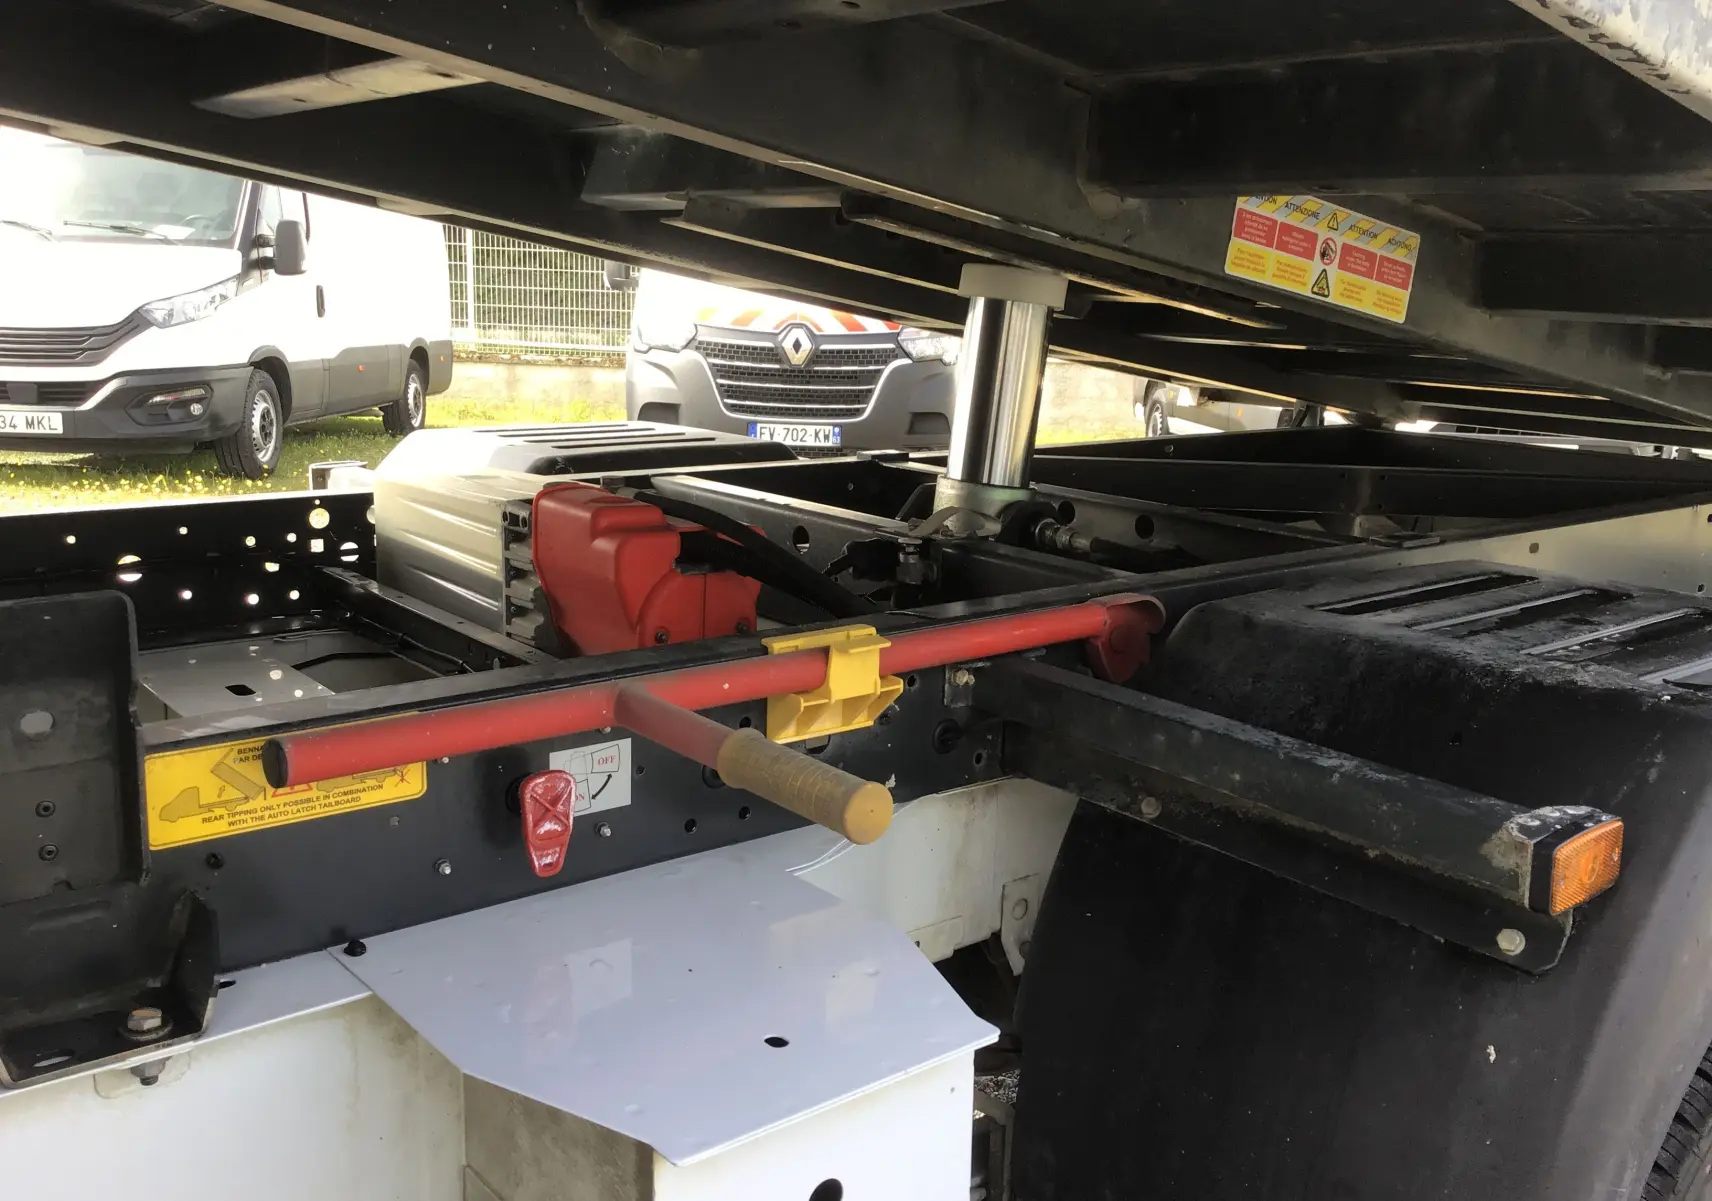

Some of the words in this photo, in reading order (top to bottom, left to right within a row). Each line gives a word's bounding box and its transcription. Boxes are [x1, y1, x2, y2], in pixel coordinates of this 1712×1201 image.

[1284, 201, 1321, 220] ATTENZIONE
[1348, 225, 1378, 240] ATTENTION
[25, 415, 58, 431] MKL
[597, 755, 616, 765] OFF
[201, 814, 225, 825] REAR
[226, 808, 258, 819] TIPPING
[259, 803, 282, 813] ONLY
[283, 795, 321, 808] POSSIBLE
[322, 793, 331, 801] IN
[332, 783, 384, 799] COMBINATION
[227, 818, 248, 828] WITH
[250, 814, 265, 823] THE
[267, 810, 289, 820] AUTO
[291, 804, 317, 815] LATCH
[318, 796, 361, 810] TAILBOARD
